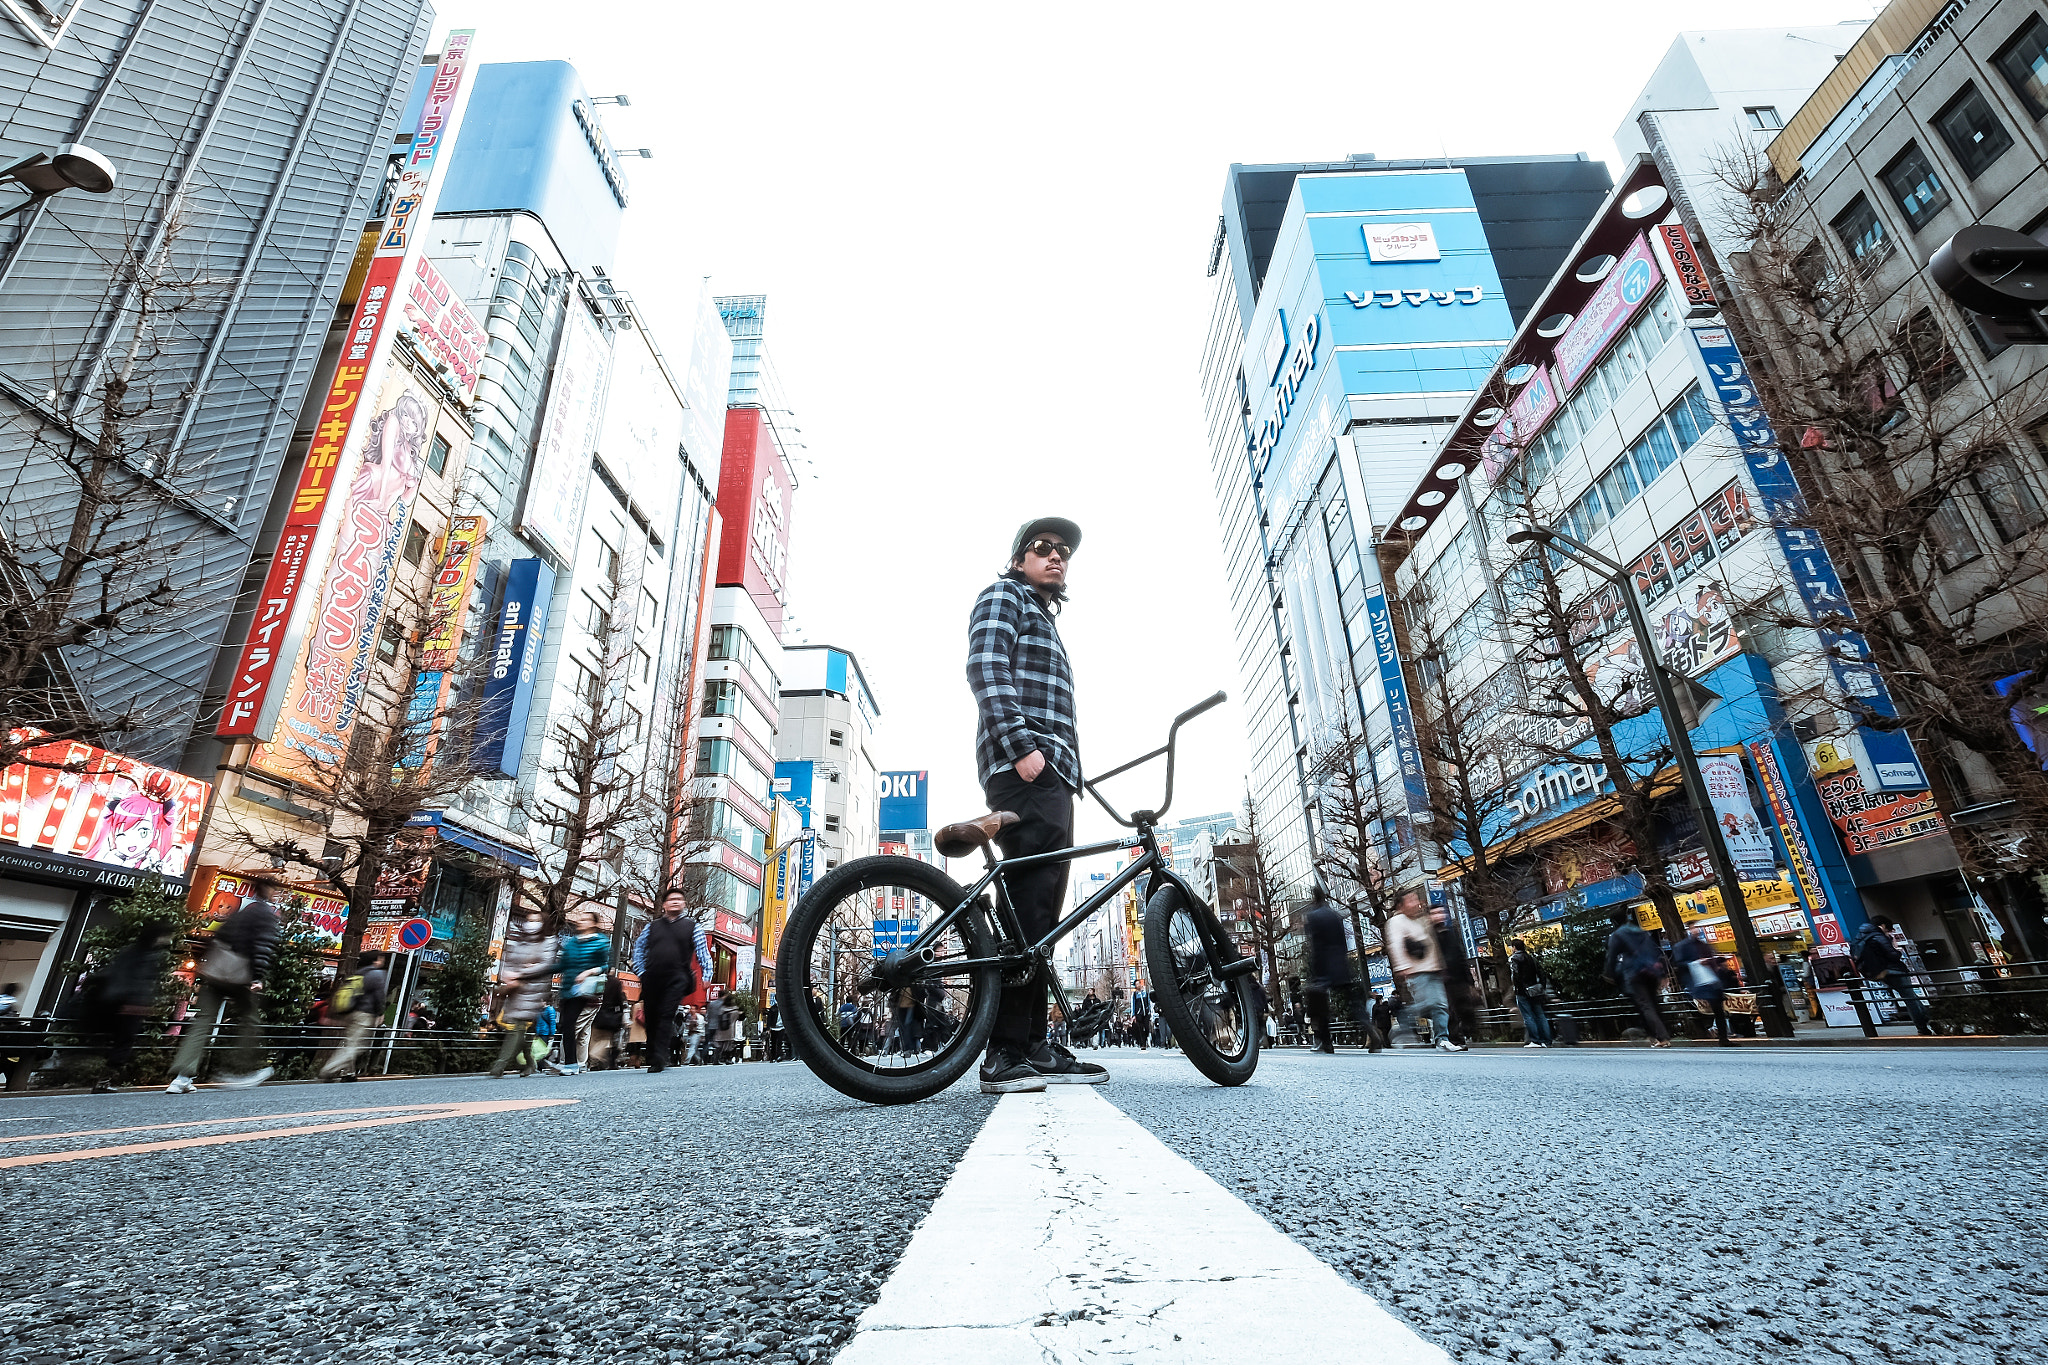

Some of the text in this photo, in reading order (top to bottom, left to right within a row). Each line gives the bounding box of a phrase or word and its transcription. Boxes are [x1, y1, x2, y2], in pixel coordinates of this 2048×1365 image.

[411, 35, 471, 165] 東京レジャーランド
[402, 172, 421, 182] 6F
[380, 194, 422, 249] ゲーム
[416, 255, 449, 304] DVD
[1345, 285, 1484, 309] ソフマップ
[348, 285, 387, 360] 激安の殿堂
[440, 314, 480, 372] BOOK
[294, 366, 365, 513] ドン・キホーテ
[280, 535, 297, 565] SLOT
[283, 534, 309, 596] PACHINKO
[228, 598, 289, 727] アイランド
[494, 601, 524, 679] animate
[521, 606, 544, 684] animate
[1371, 609, 1394, 664] ソフマップ
[297, 649, 331, 717] アキバ
[1819, 751, 1834, 762] 6F
[1880, 769, 1916, 778] Sofmap
[879, 774, 917, 798] OKI
[45, 864, 64, 874] AND
[67, 867, 90, 878] SLOT
[95, 870, 136, 889] AKIBA
[374, 885, 421, 896] DRIFTERS
[312, 897, 345, 914] GAME
